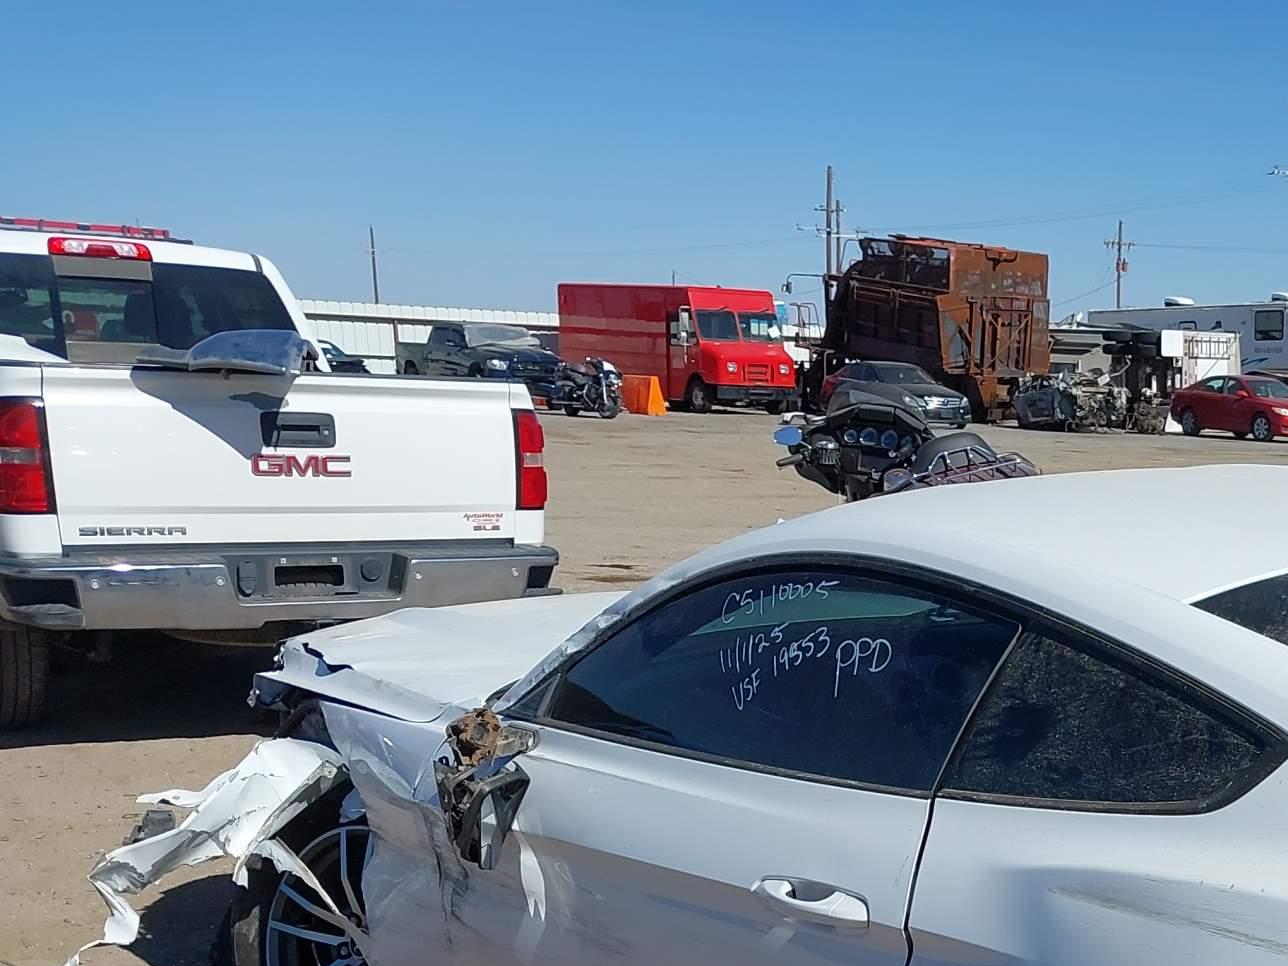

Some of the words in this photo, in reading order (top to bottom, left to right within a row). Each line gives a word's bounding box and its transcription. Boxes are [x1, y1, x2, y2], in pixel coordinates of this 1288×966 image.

[251, 455, 352, 478] GMC
[78, 526, 187, 537] SIERRA
[833, 637, 893, 699] PPD
